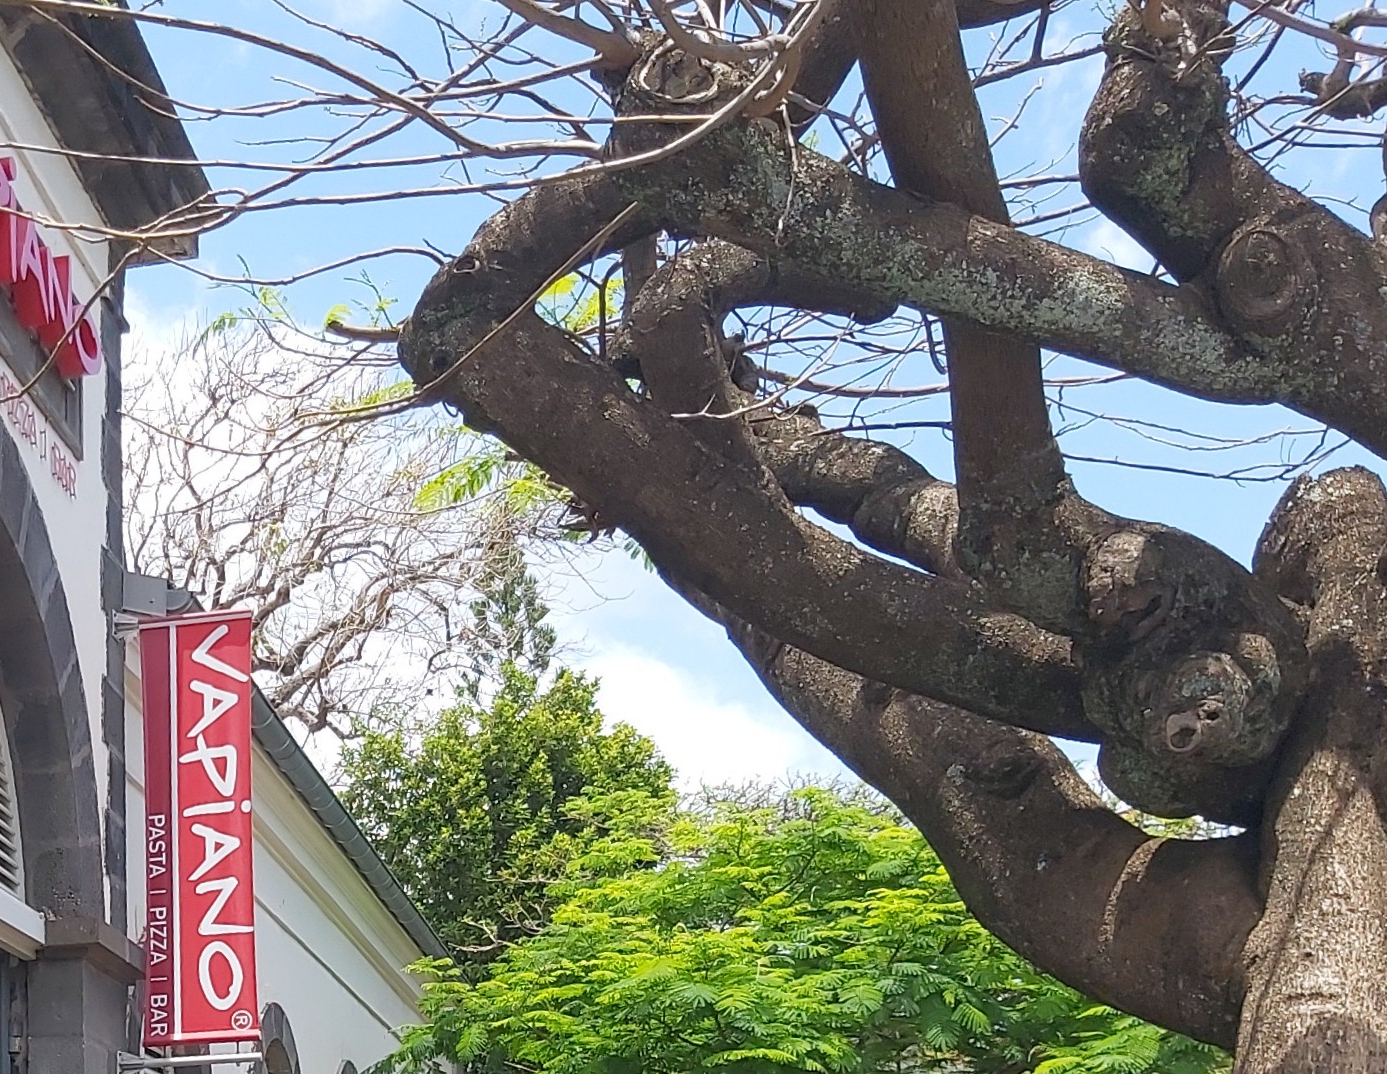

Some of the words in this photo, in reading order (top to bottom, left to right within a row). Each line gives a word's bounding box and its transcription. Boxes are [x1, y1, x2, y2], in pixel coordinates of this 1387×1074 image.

[147, 813, 166, 881] PASTA
[148, 906, 168, 967] PIZZA
[149, 995, 168, 1037] BAR
